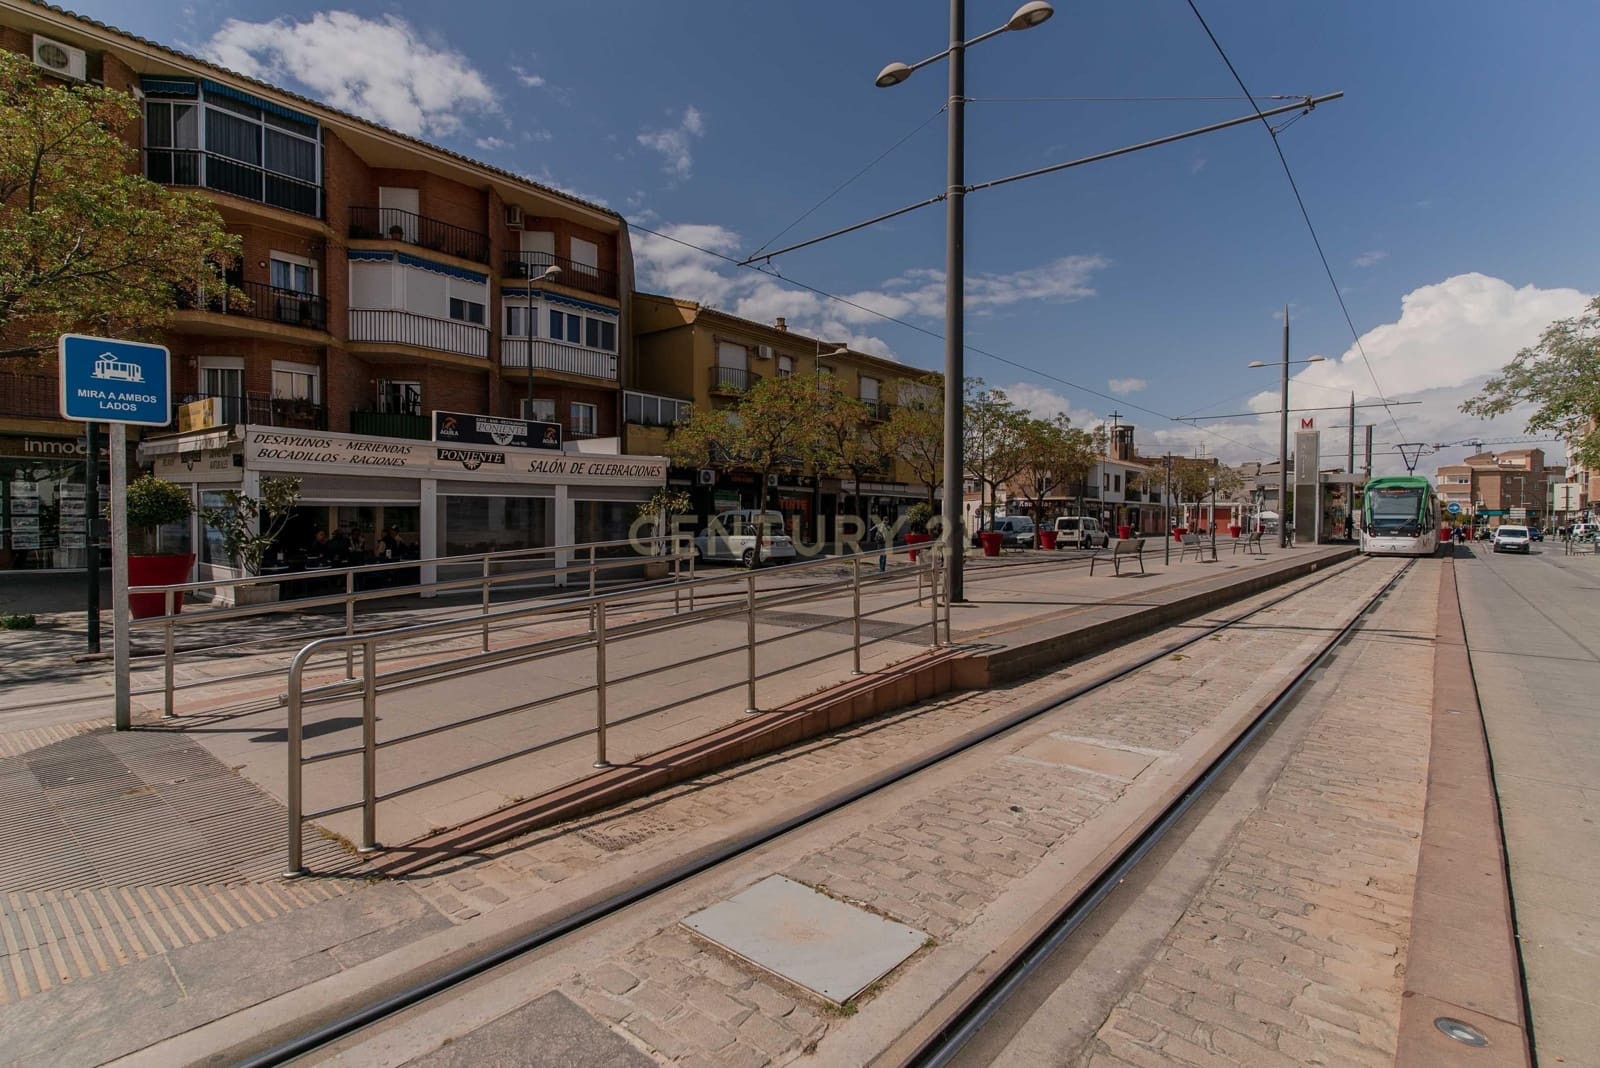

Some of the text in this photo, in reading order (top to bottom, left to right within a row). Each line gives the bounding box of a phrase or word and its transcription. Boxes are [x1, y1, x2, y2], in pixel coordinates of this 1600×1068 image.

[77, 389, 157, 404] MIRA A AMBOS
[99, 401, 137, 411] LADOS
[477, 423, 526, 435] PONIENTE
[1301, 417, 1313, 429] M
[253, 434, 333, 448] DESAYUNOS
[346, 441, 413, 455] MERIENDAS
[257, 448, 339, 463] BOCADILLOS
[349, 455, 407, 467] RACIONES
[440, 450, 504, 463] PONIENTE
[528, 458, 662, 477] SALÓN DE CELEBRACIONES
